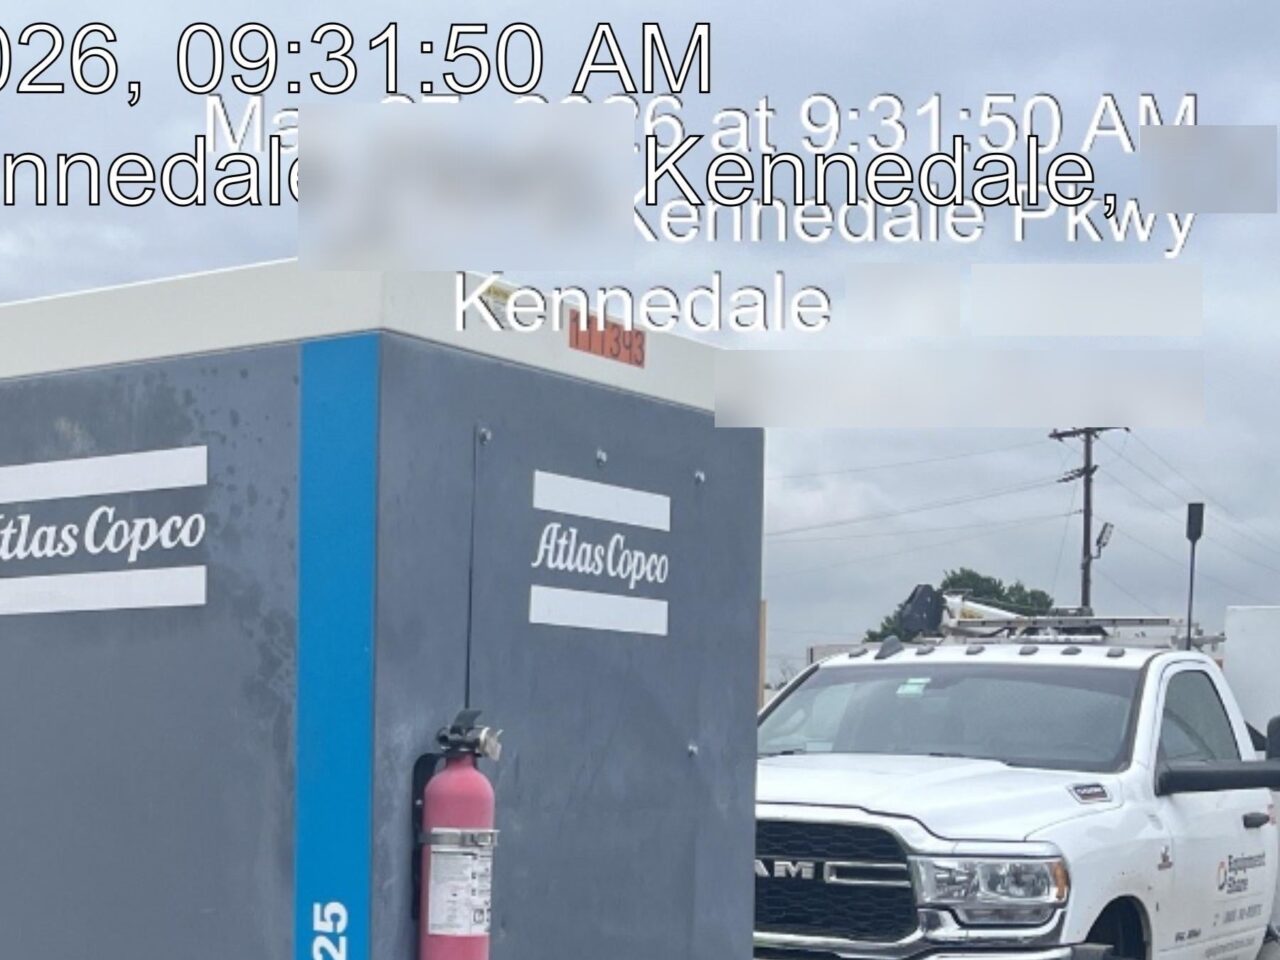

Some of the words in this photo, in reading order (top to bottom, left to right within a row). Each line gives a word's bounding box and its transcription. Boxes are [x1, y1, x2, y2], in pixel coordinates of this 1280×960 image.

[83, 505, 206, 563] Copco
[531, 522, 605, 576] Atlas
[607, 532, 669, 589] Copco
[754, 858, 815, 879] AM
